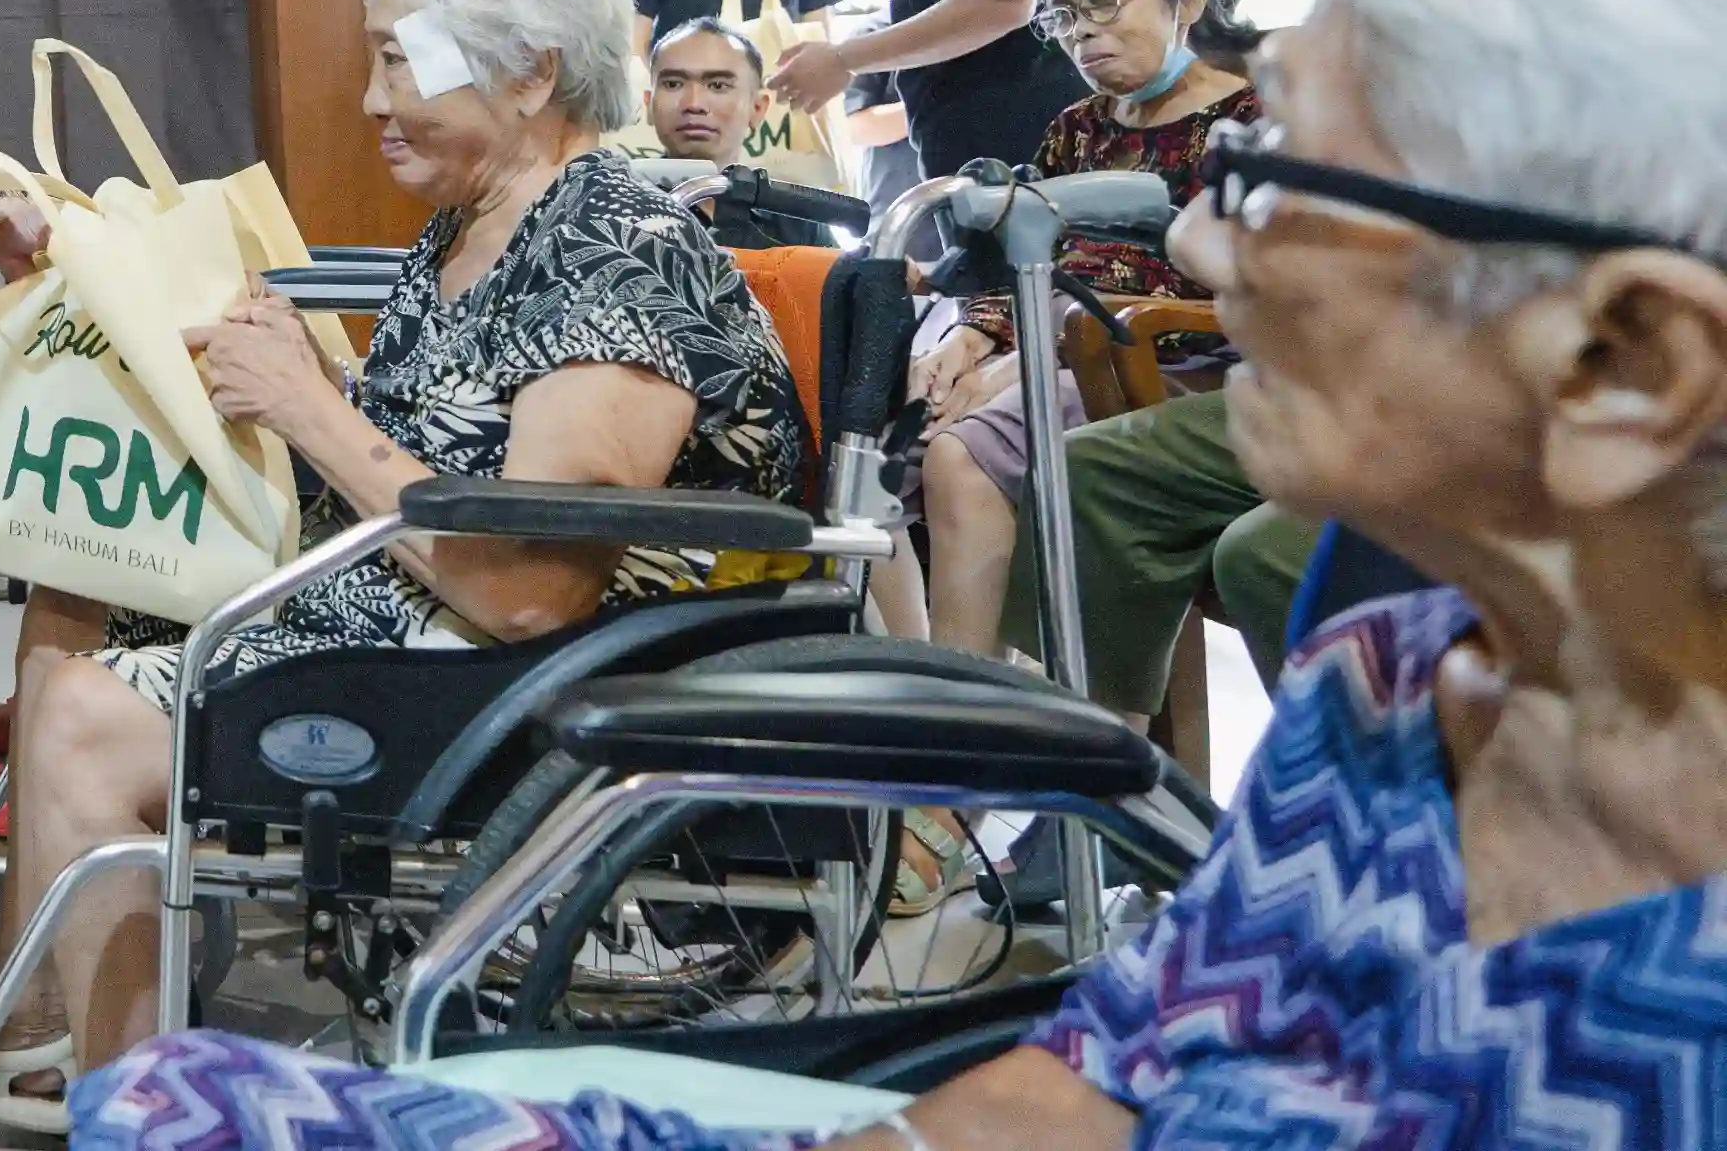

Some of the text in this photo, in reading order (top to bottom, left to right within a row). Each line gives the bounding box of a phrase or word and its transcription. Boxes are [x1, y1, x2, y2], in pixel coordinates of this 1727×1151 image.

[2, 405, 207, 546] HRM
[8, 519, 179, 577] BY HARUM BALI
